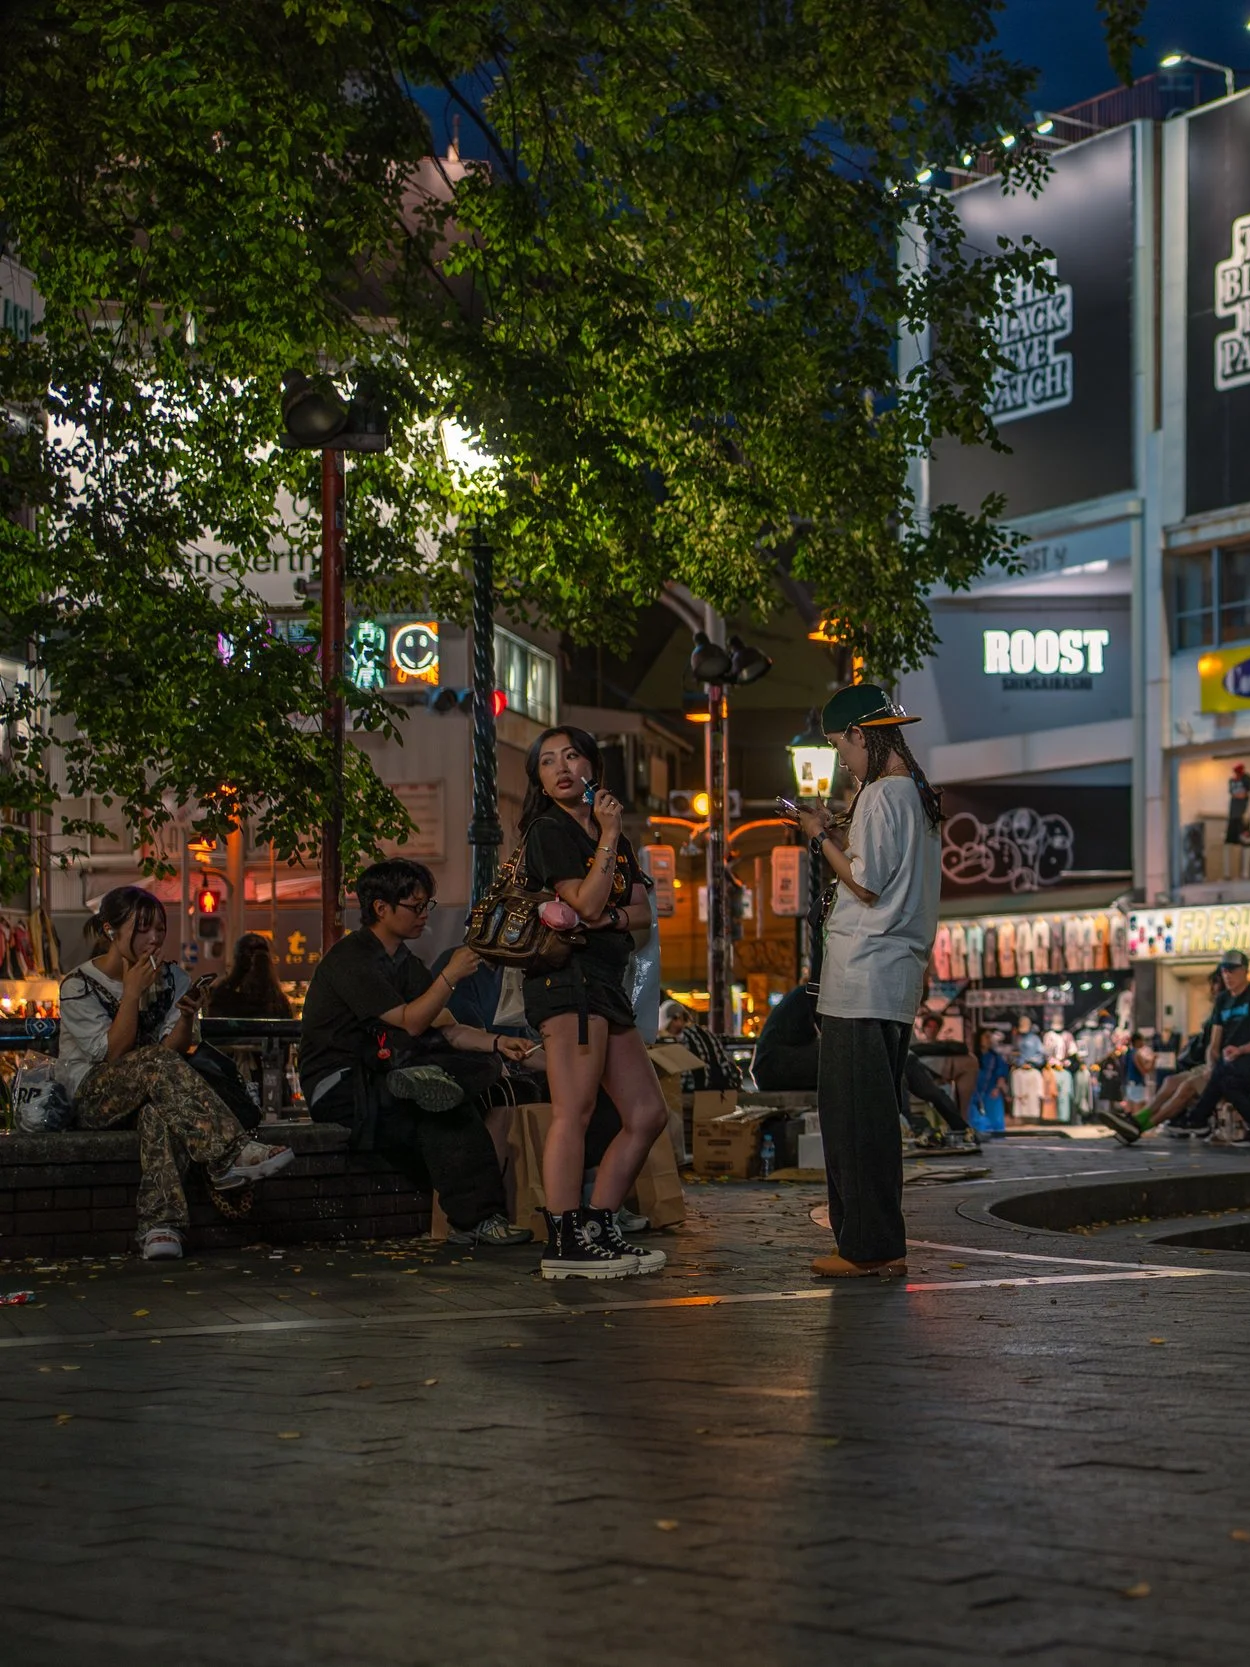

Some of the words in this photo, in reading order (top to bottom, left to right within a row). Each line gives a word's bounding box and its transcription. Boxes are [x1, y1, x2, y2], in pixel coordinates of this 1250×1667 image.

[986, 296, 1066, 345] LACK
[986, 361, 1064, 410] ATCH
[983, 629, 1109, 675] ROOST
